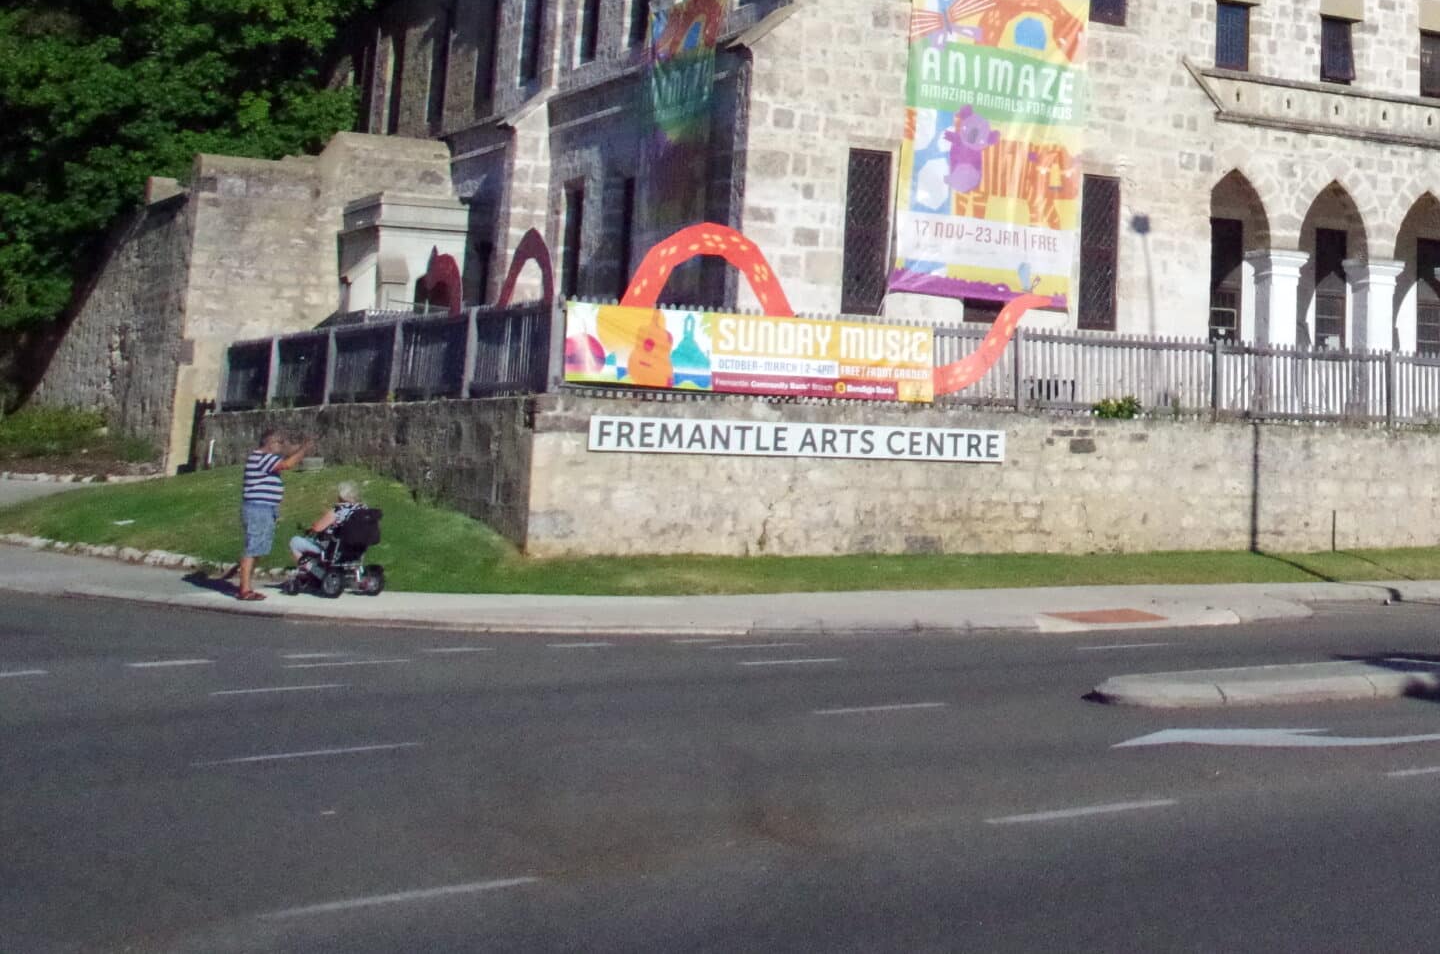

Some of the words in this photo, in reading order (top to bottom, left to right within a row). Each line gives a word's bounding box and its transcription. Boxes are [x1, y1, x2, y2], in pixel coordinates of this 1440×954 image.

[921, 46, 1075, 105] ANIMAZE
[920, 83, 975, 104] AMAZING
[975, 92, 1023, 113] ANIMALS
[914, 219, 930, 237] 17
[995, 229, 1020, 247] JAN
[1031, 233, 1059, 253] FREE
[718, 317, 832, 357] SUNDAY
[840, 326, 929, 363] MUSIC
[597, 420, 789, 452] FREMANTLE
[799, 427, 876, 455] ARTS
[886, 430, 1000, 458] CENTRE
